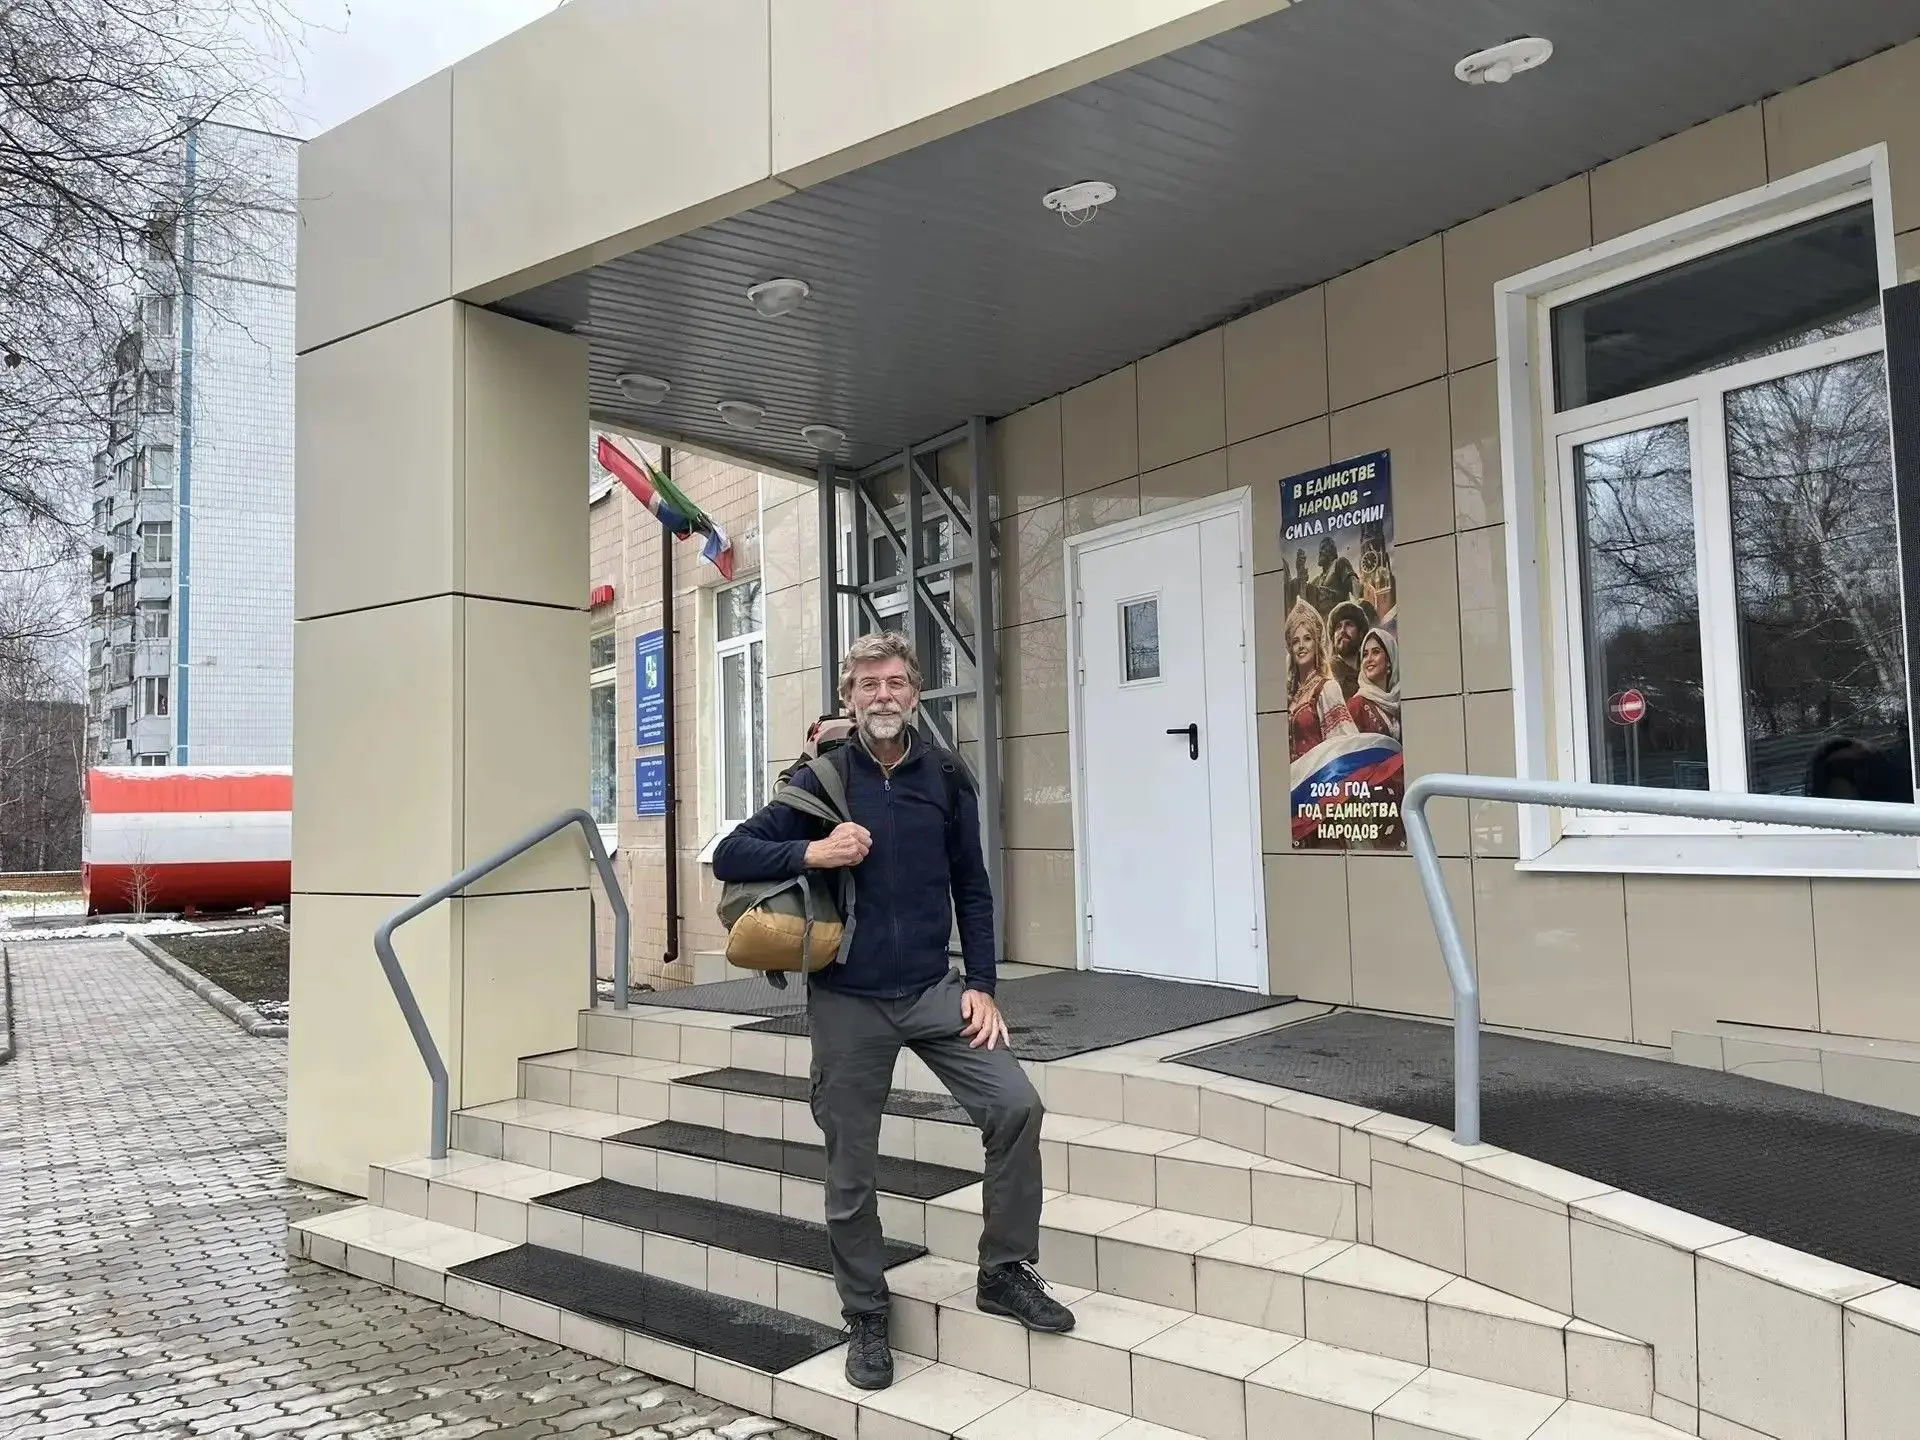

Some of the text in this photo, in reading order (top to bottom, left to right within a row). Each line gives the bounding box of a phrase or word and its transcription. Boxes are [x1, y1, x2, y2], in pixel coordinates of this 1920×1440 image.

[1293, 463, 1376, 499] В ЕДИНСТВЕ
[1298, 489, 1358, 518] НАРОДОВ
[1285, 504, 1385, 540] СИЛА РОССИИ!
[1310, 782, 1340, 798] 2026
[1344, 781, 1371, 799] ГОД
[1298, 802, 1399, 821] ГОД ЕДИНСТВА
[1318, 823, 1378, 842] НАРОДОВ
